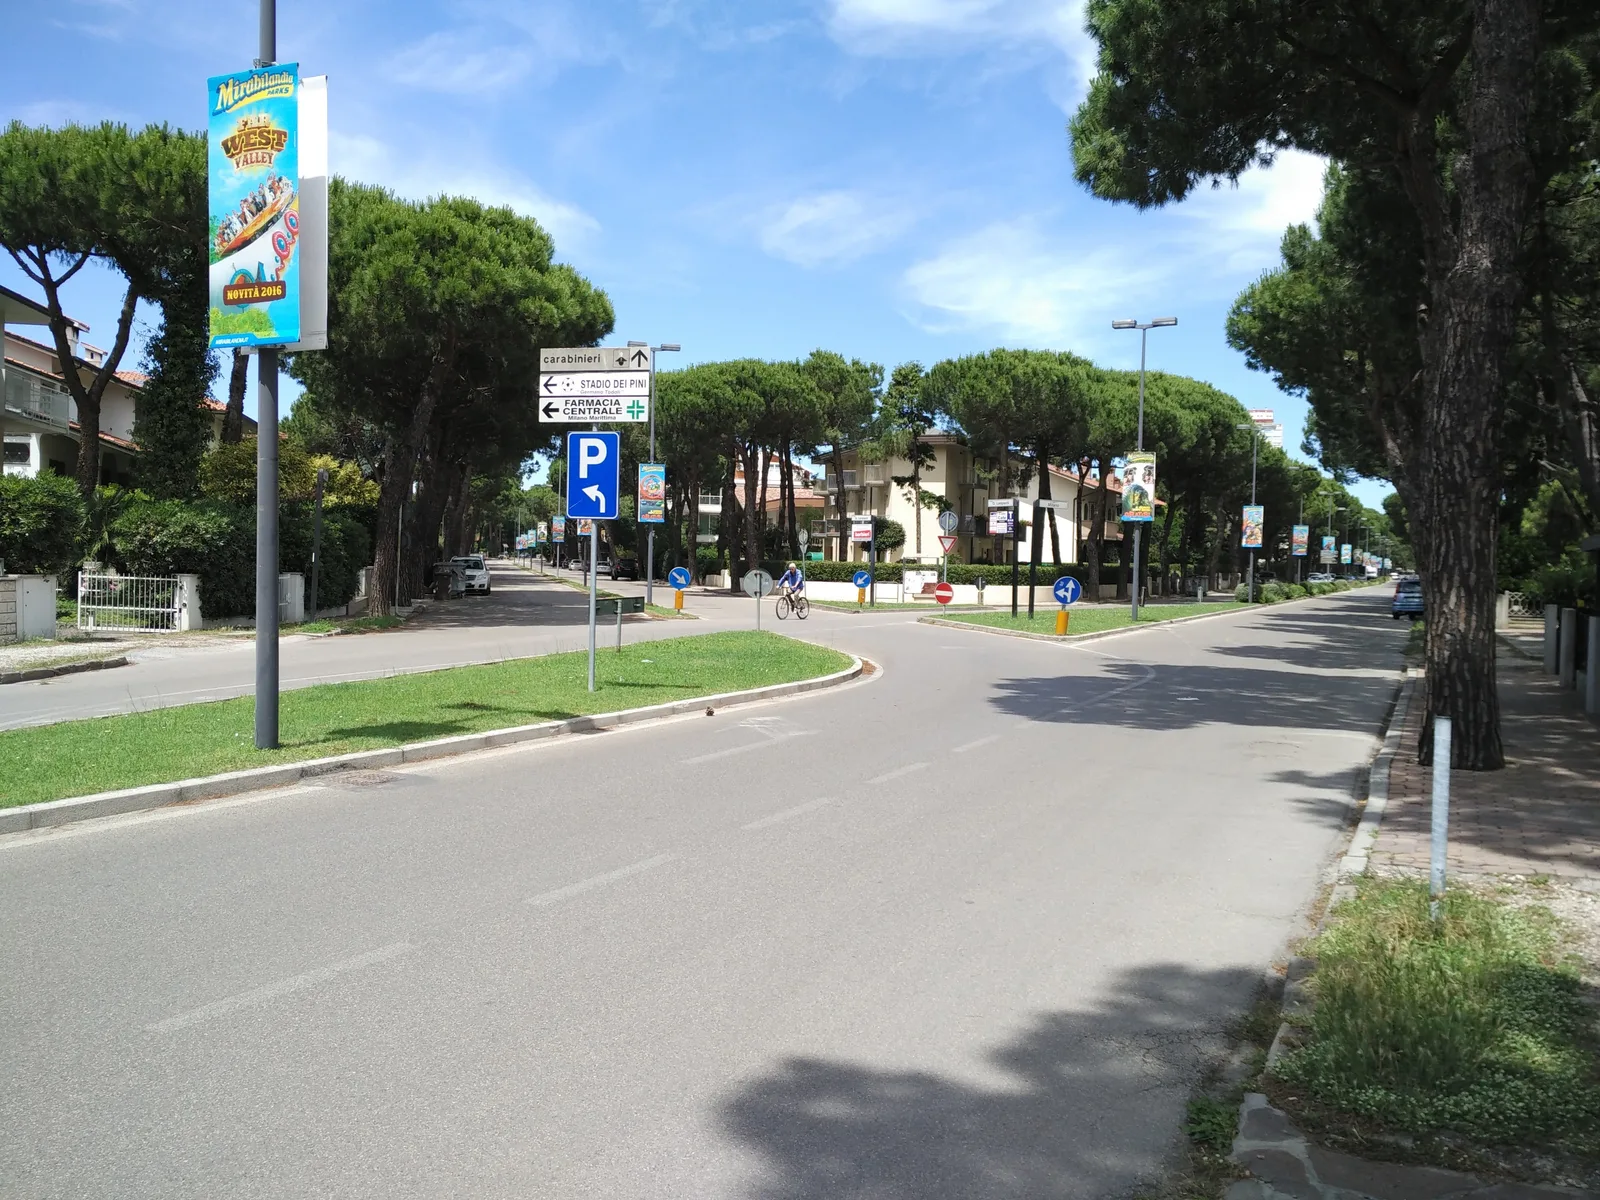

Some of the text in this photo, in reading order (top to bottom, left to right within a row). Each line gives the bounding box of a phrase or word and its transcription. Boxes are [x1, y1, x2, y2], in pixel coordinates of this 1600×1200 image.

[215, 72, 294, 111] Mirabilandia
[267, 87, 289, 96] PARKS
[221, 129, 288, 158] WEST
[234, 152, 274, 169] VALLEY
[227, 285, 282, 300] NOVITÀ 2016
[543, 353, 601, 364] carabinieri
[580, 379, 647, 389] STADIO DEI PINI
[564, 399, 621, 407] FARMACIA
[562, 407, 623, 415] CENTRALE
[579, 437, 608, 479] P
